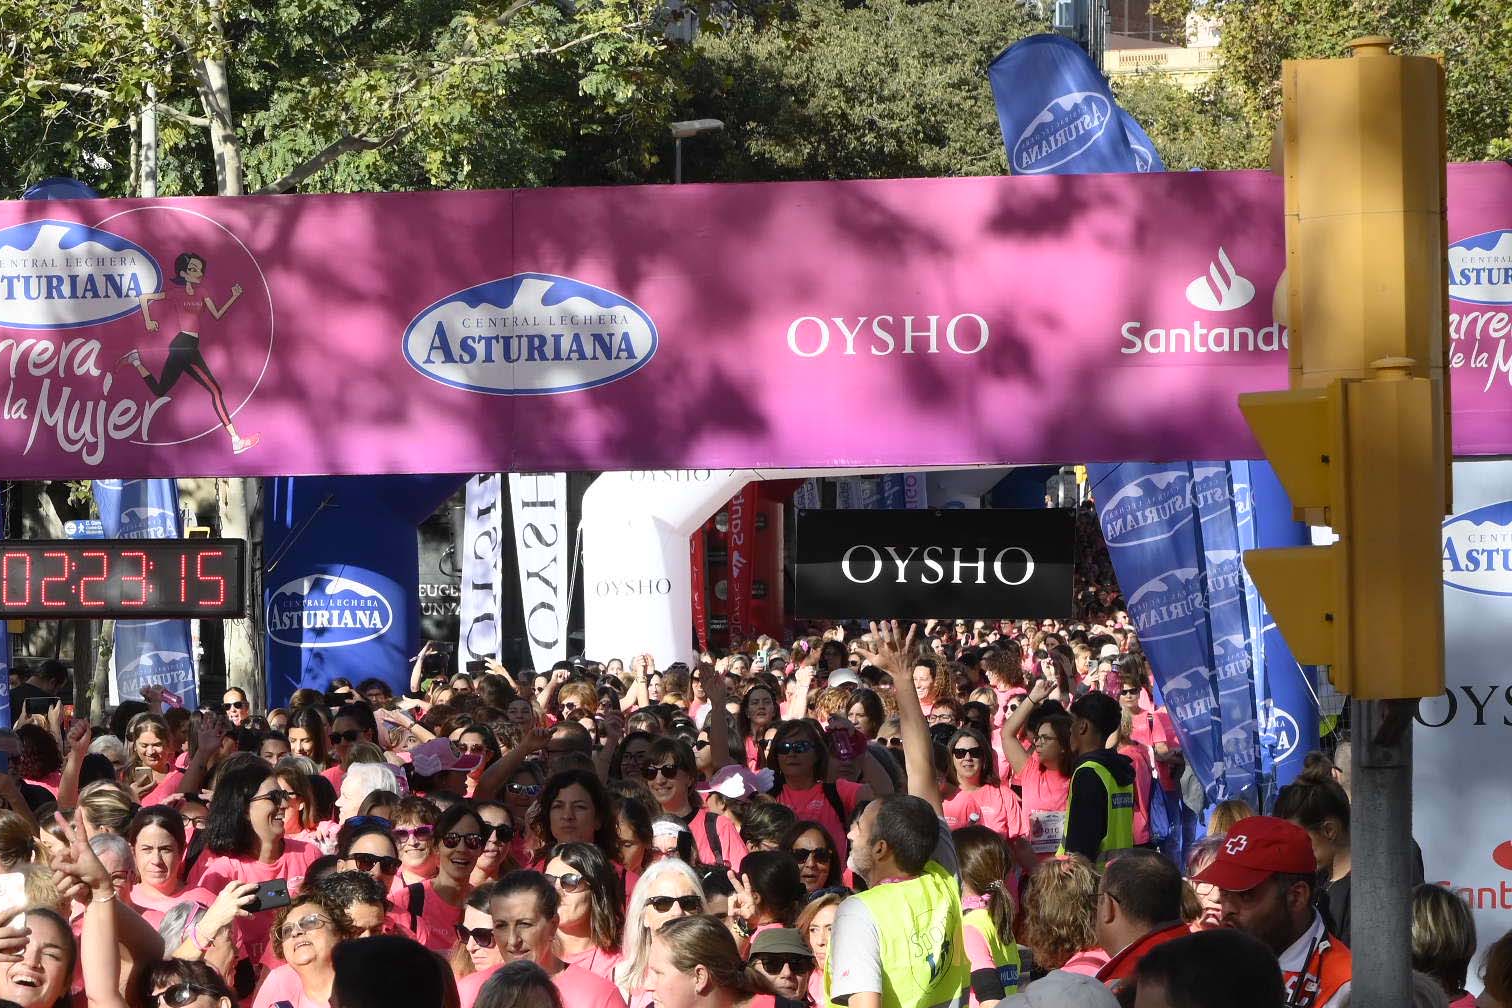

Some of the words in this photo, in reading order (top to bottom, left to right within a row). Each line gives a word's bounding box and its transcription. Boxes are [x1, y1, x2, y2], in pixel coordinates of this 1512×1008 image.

[66, 255, 138, 268] LECHERA
[422, 320, 638, 366] ASTURIANA
[462, 317, 539, 329] CENTRAL
[549, 314, 629, 328] LECHERA
[787, 312, 989, 358] OYSHO
[3, 377, 28, 420] la
[23, 371, 172, 466] Mujer
[1, 550, 225, 606] 02:23:15
[841, 544, 1035, 586] OYSHO
[270, 605, 383, 631] ASTURIANA
